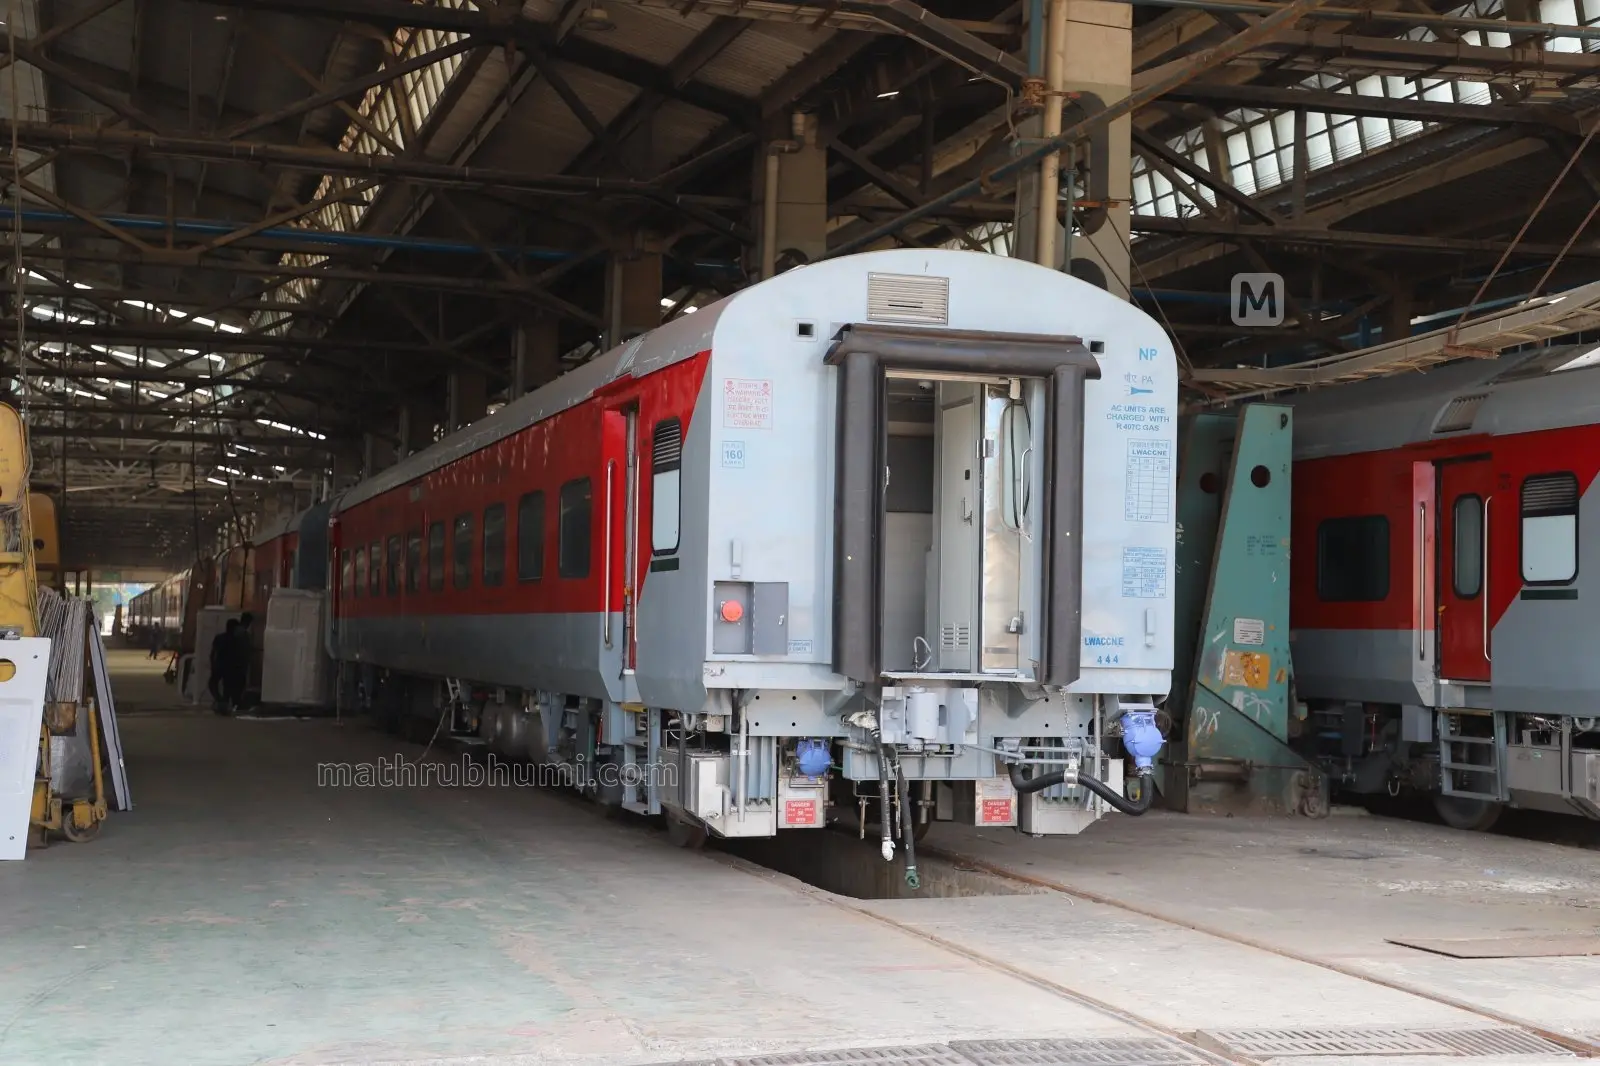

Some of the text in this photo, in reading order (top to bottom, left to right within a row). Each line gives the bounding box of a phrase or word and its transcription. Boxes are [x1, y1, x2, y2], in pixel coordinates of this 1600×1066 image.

[1138, 347, 1158, 361] NP
[1141, 374, 1154, 385] PA
[1110, 404, 1166, 414] AC UNITS ARE
[1106, 413, 1170, 423] CHARGED WITH
[1142, 424, 1160, 432] GAS
[725, 449, 743, 460] 160
[1132, 449, 1168, 457] LWACCNE
[1084, 636, 1125, 647] LWACCNE
